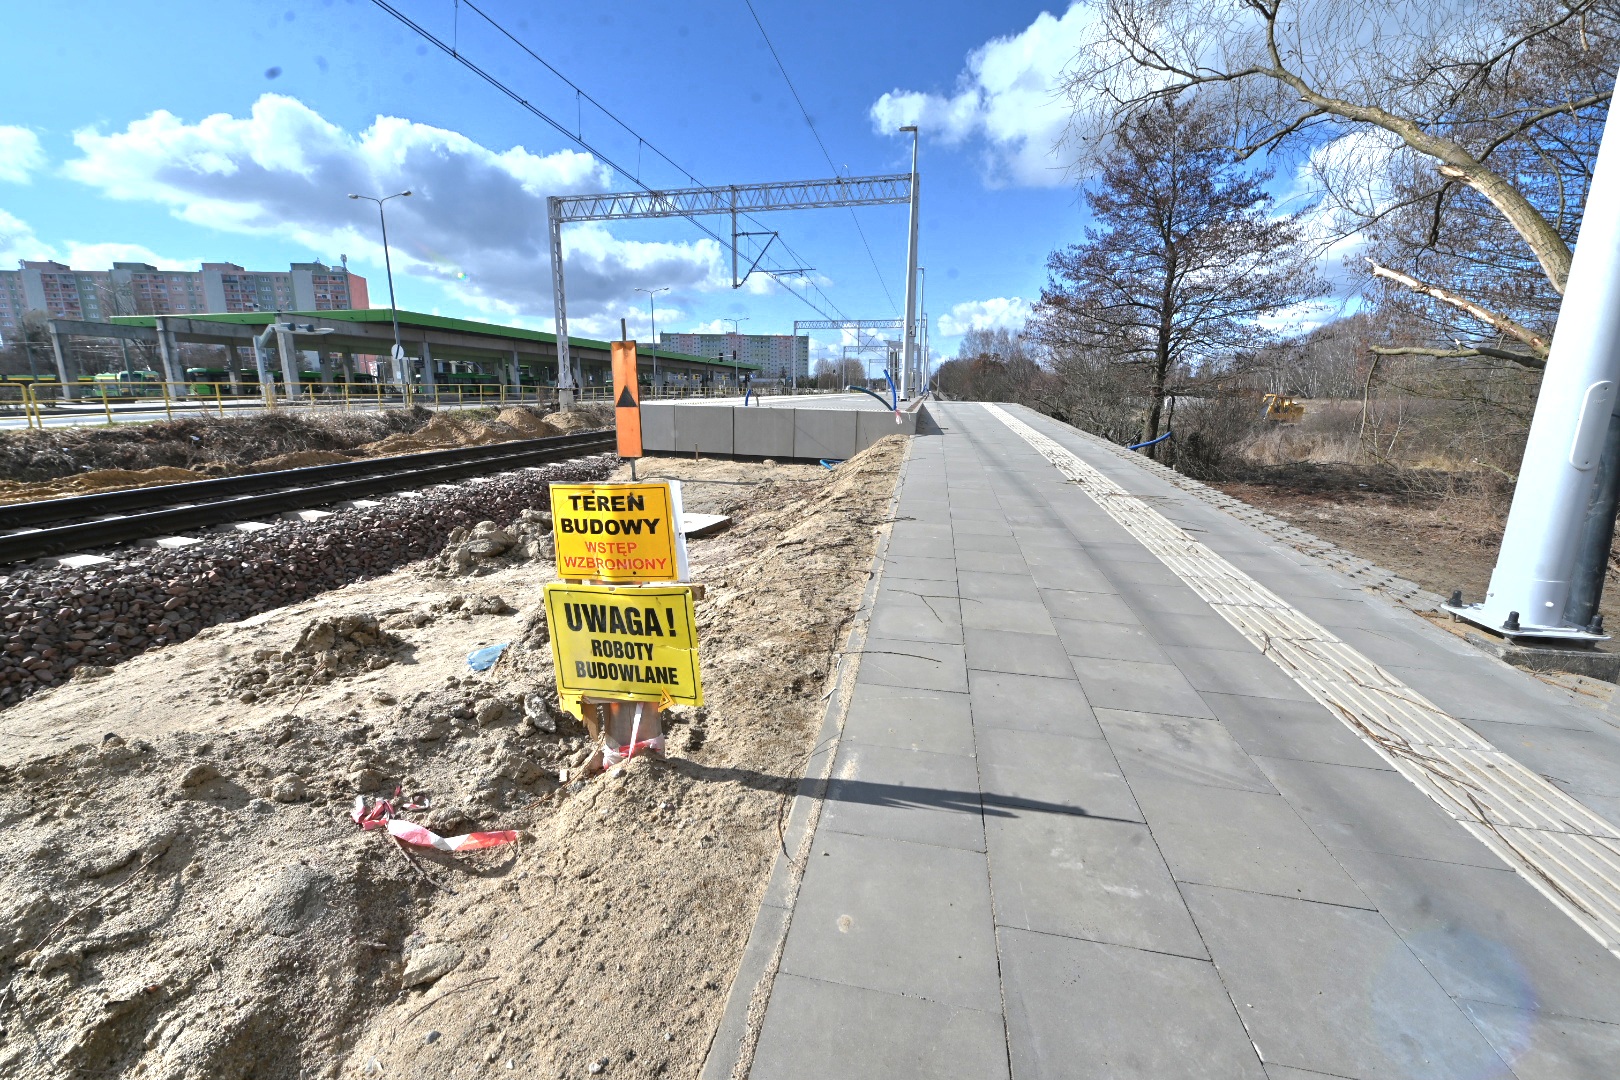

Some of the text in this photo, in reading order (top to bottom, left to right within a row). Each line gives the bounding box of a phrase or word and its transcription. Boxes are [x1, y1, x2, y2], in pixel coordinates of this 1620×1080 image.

[568, 495, 645, 512] TEREN
[560, 518, 660, 535] BUDOWY
[585, 541, 637, 556] WSTĘP
[564, 556, 667, 570] WZBRONIONY
[591, 639, 653, 661] ROBOTY
[575, 660, 679, 685] BUDOWLANE
